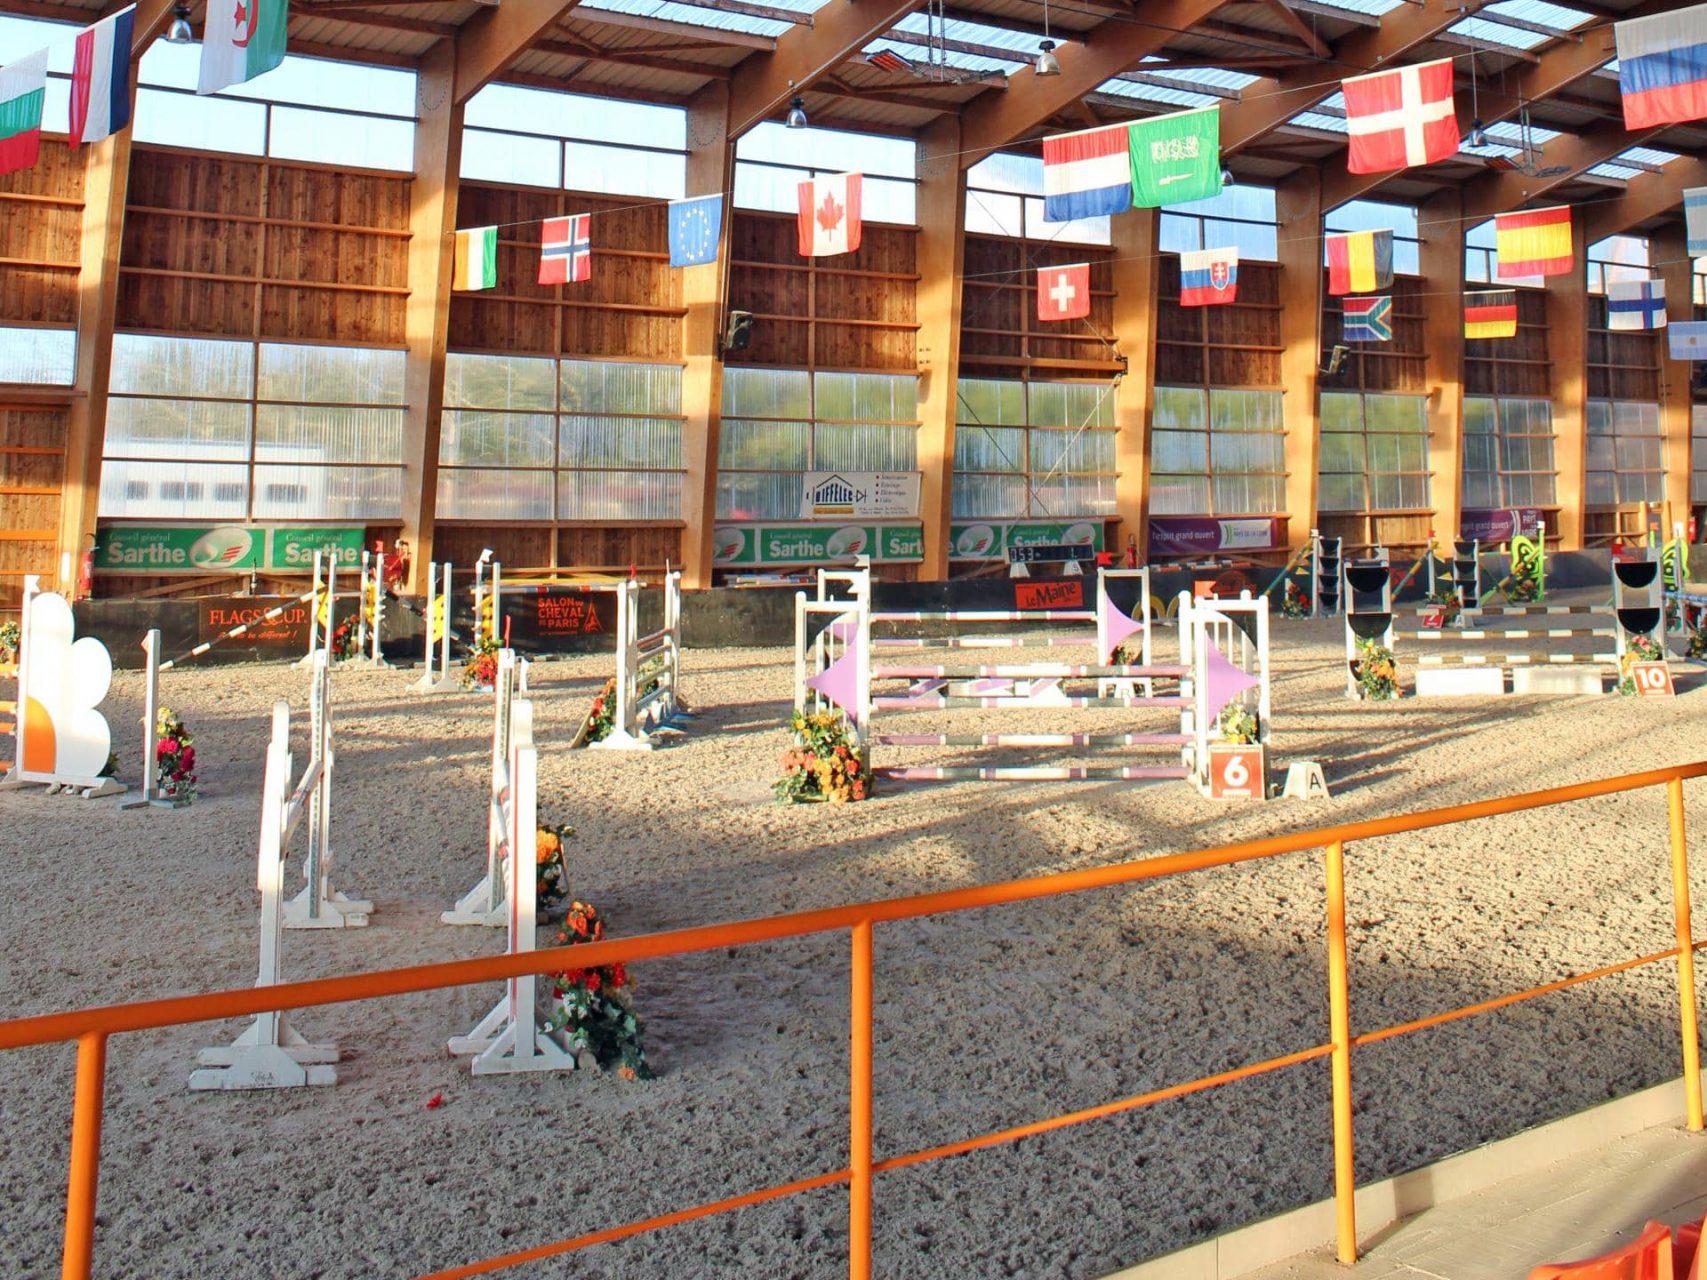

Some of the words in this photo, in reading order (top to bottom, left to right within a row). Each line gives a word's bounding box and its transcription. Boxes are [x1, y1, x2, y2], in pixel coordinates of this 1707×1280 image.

[108, 542, 186, 563] Sarthe
[285, 542, 358, 563] Sathe
[769, 540, 825, 558] Sarthe
[538, 597, 574, 607] SALON
[1035, 583, 1076, 605] Maine
[538, 607, 584, 618] CHEVAL
[547, 618, 579, 628] PARIS
[1636, 667, 1667, 689] 10
[1223, 755, 1249, 787] 6
[1309, 771, 1321, 790] A
